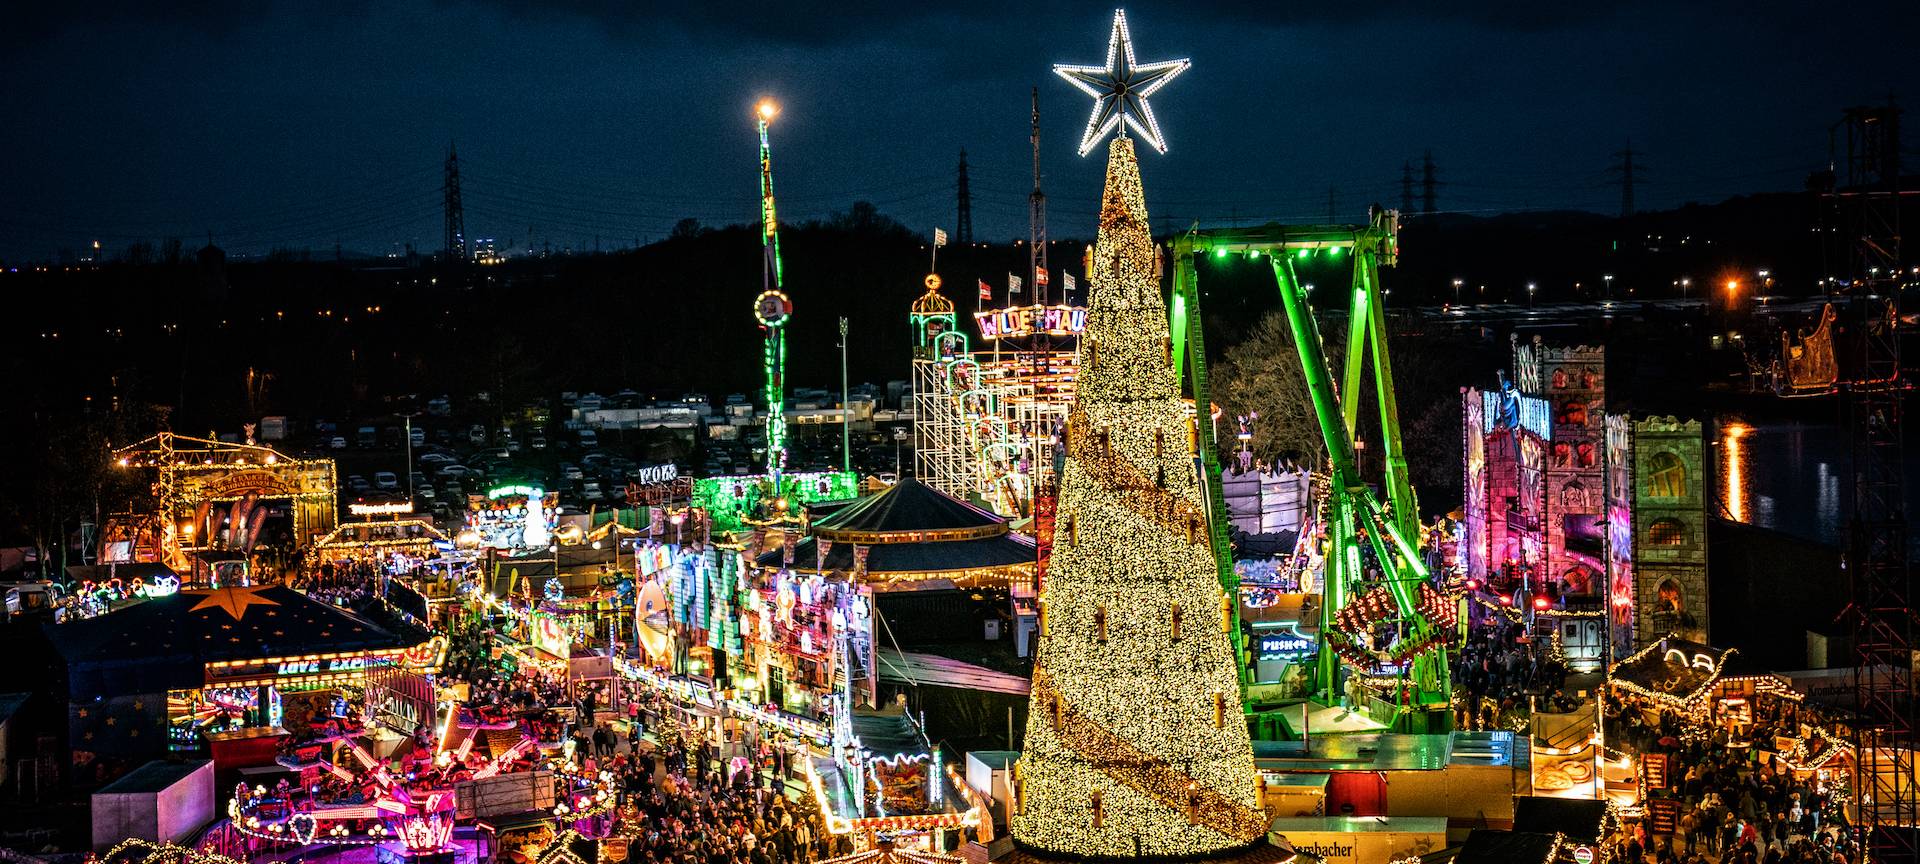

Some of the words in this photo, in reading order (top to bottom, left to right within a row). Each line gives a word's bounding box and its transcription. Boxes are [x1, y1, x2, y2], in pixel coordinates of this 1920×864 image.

[980, 311, 1030, 336] WILDE
[1263, 640, 1308, 651] PUSHER
[277, 660, 320, 675] LOVE
